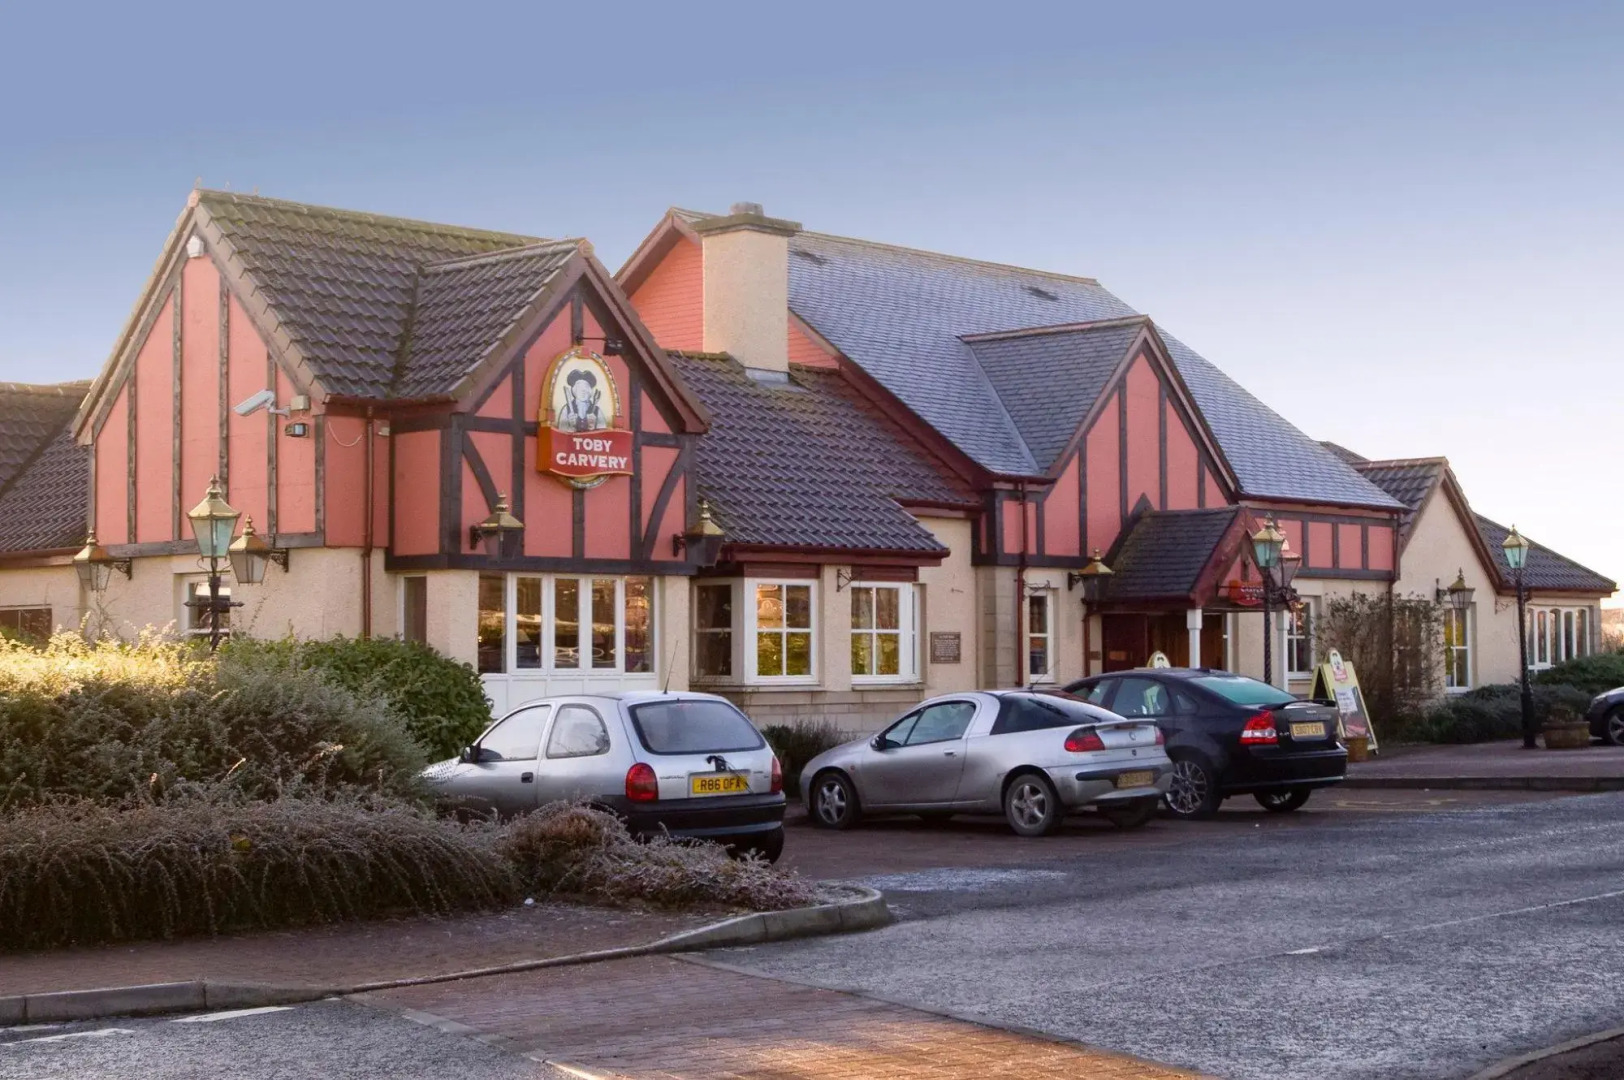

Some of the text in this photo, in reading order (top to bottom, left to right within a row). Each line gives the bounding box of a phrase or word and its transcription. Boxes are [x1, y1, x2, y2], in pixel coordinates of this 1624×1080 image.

[573, 437, 612, 452] TOBY
[556, 452, 627, 468] CARVERY
[700, 778, 721, 791] R86
